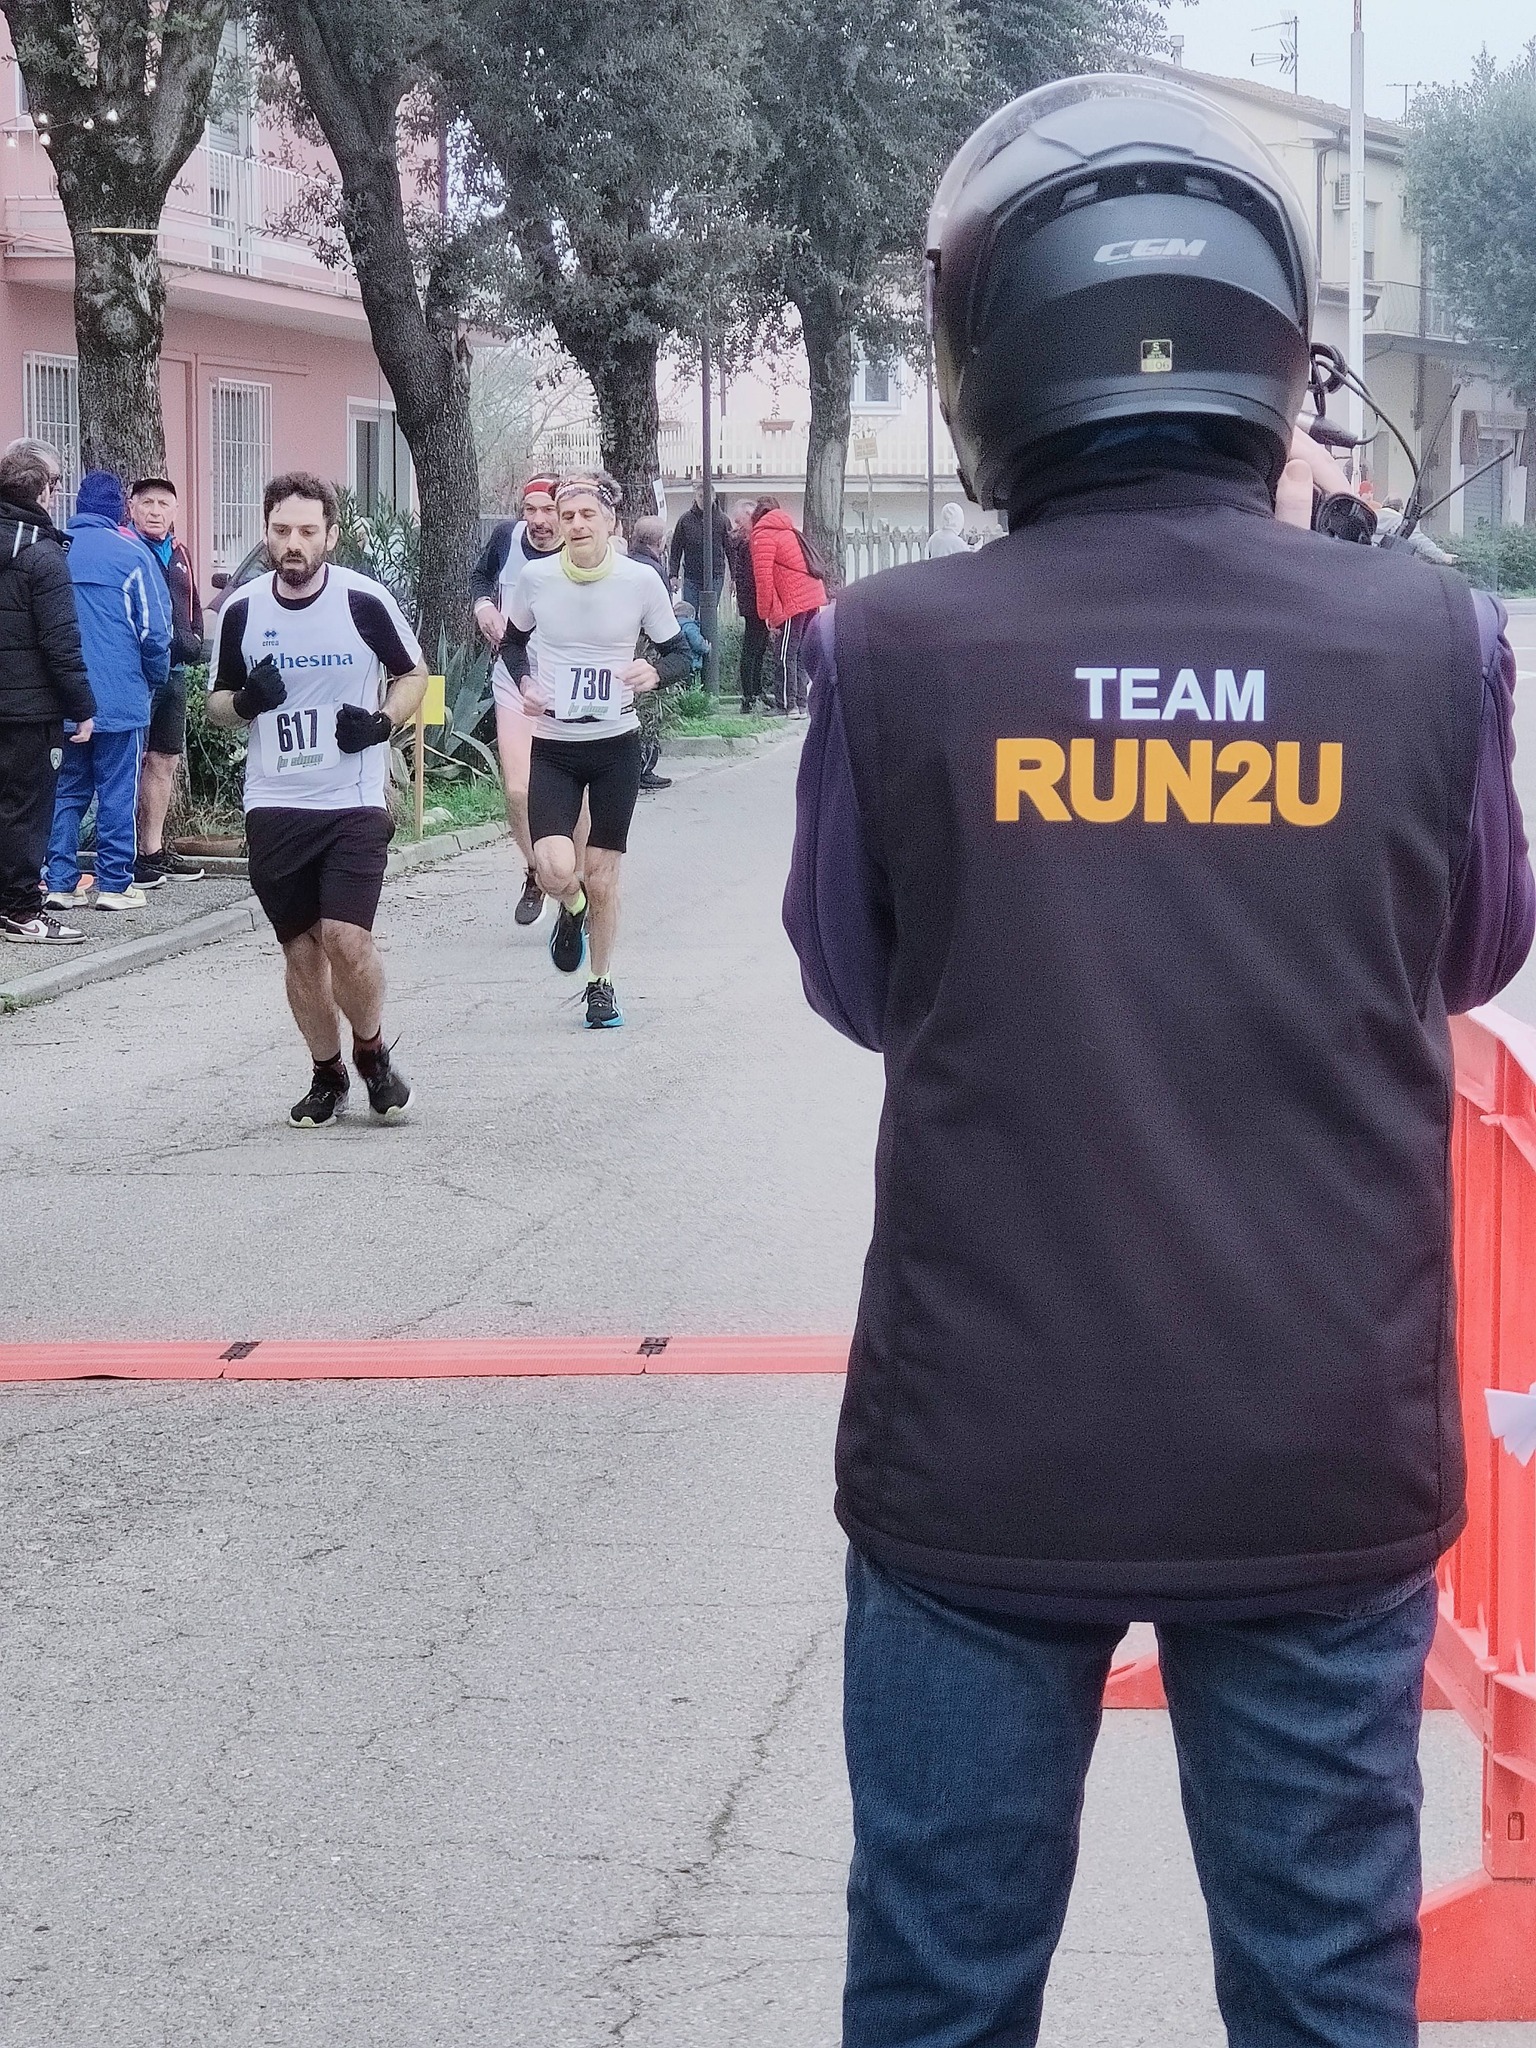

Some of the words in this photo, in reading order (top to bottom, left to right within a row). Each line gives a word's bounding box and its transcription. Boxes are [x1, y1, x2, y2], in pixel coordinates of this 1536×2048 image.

[1093, 238, 1207, 263] CGM
[570, 667, 611, 701] 730
[1075, 667, 1265, 721] TEAM
[277, 709, 318, 752] 617
[995, 738, 1343, 827] RUN2U
